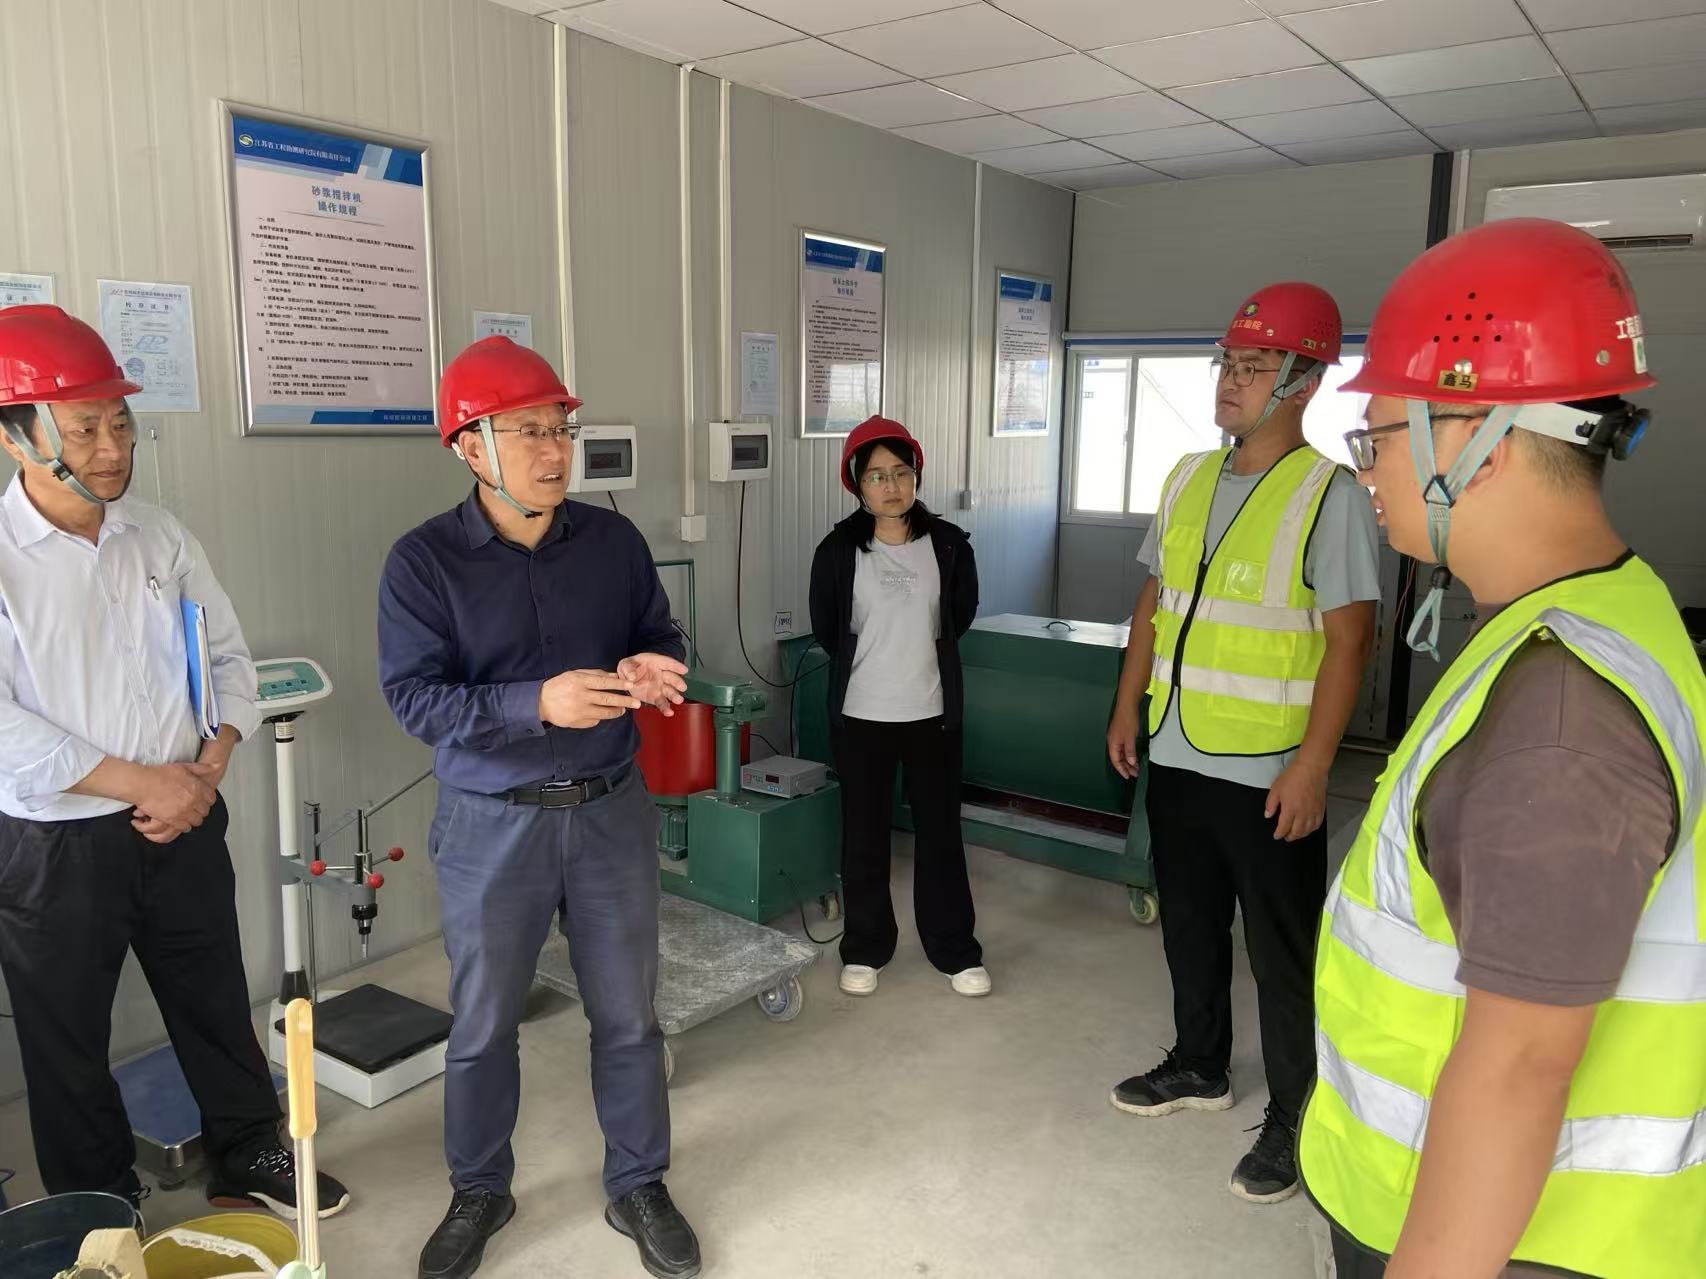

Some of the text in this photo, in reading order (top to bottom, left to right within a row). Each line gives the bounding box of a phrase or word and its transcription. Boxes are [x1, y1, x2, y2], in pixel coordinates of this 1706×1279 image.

[311, 185, 361, 203] 砂浆搅拌机
[318, 200, 358, 217] 操作规程
[1442, 372, 1473, 390] 鑫马
